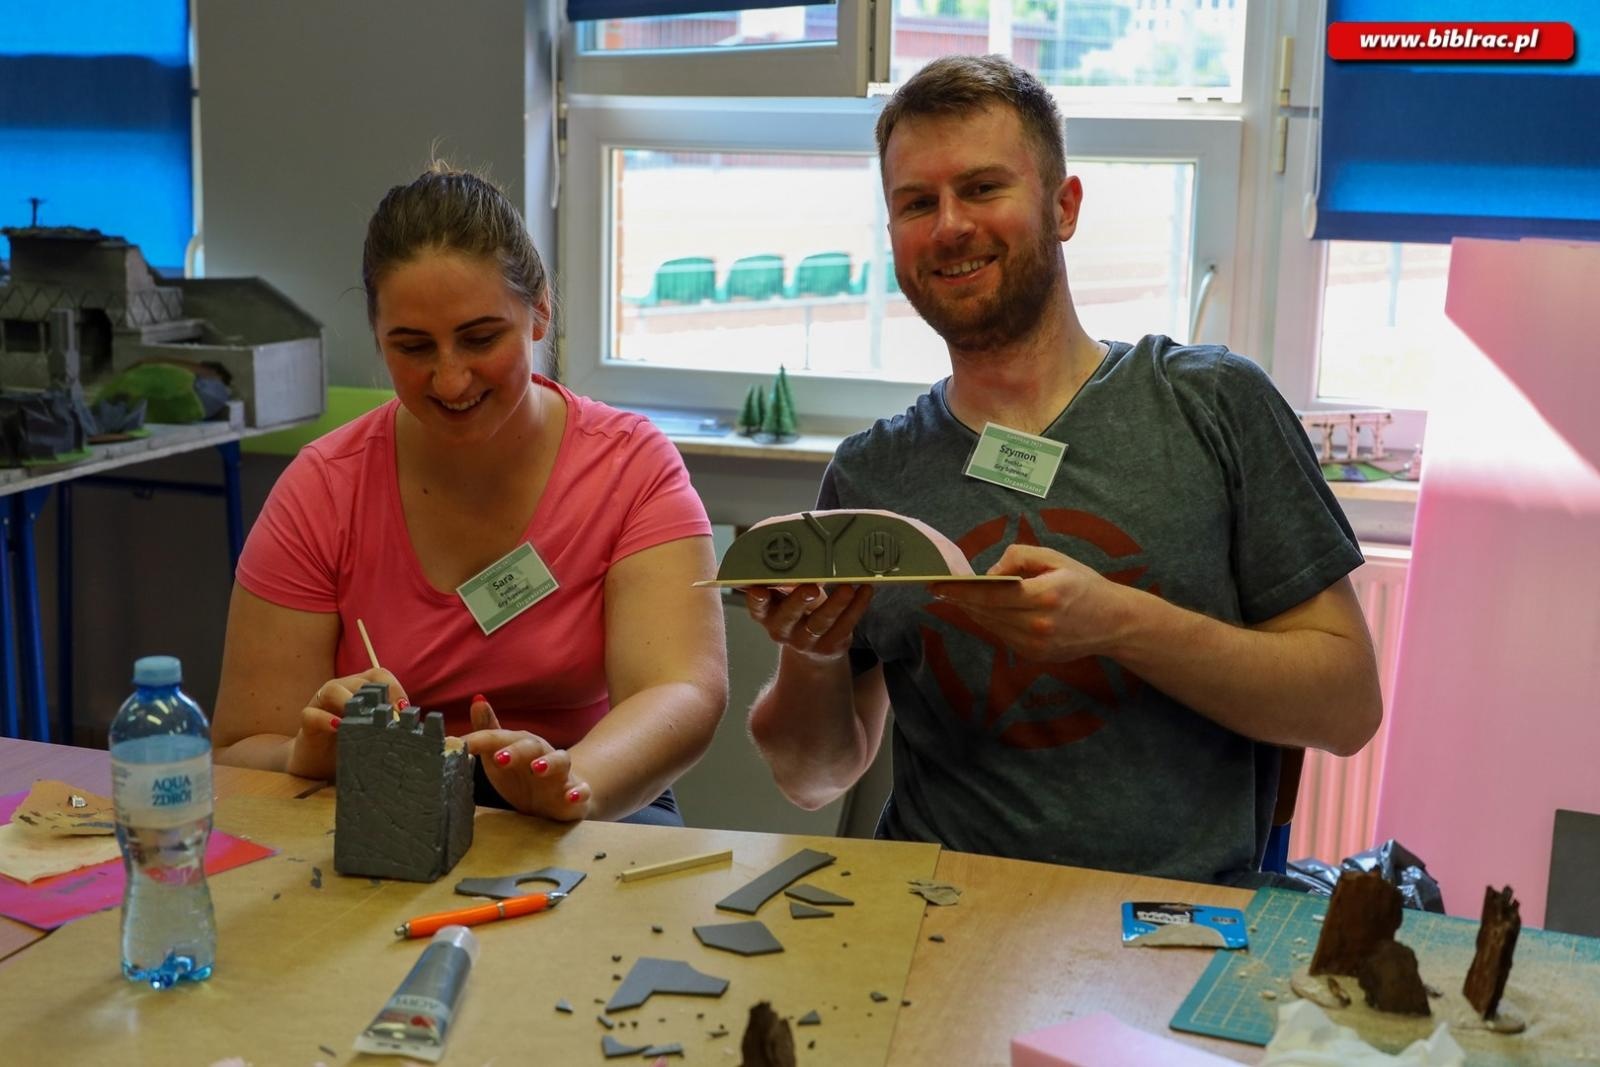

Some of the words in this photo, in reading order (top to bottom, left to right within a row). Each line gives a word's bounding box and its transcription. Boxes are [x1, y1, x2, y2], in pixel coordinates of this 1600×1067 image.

[1000, 444, 1037, 463] Szymon
[492, 573, 515, 591] Sara
[151, 774, 192, 792] AQUA
